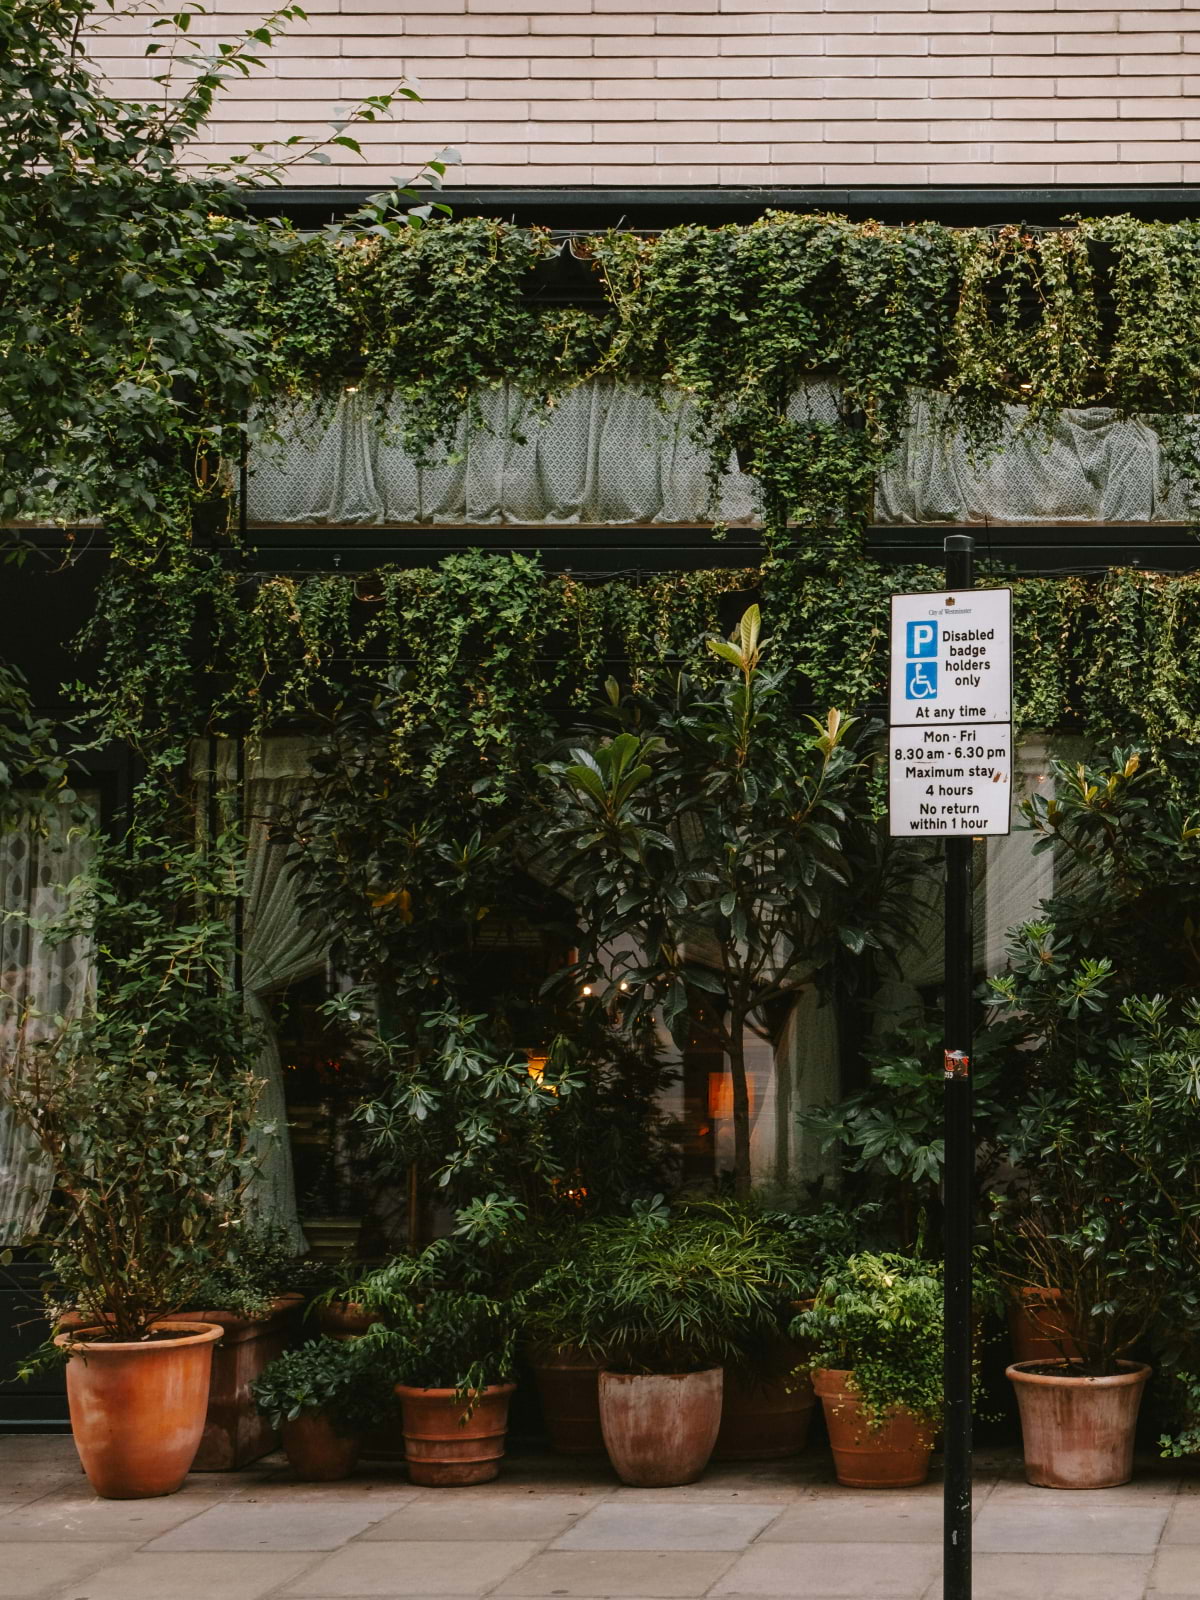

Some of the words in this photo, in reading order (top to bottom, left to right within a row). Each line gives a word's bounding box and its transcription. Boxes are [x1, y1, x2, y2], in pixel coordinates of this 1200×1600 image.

[914, 625, 933, 654] P
[942, 629, 994, 642] Disabled
[950, 645, 986, 658] badge
[945, 660, 990, 671] holders
[955, 675, 980, 687] only
[916, 707, 929, 718] At
[934, 708, 954, 719] any
[959, 705, 986, 717] time
[924, 732, 949, 742] Mon
[960, 731, 976, 742] Fri
[895, 749, 923, 760] 8.30
[927, 750, 944, 759] am
[955, 747, 984, 759] 6.30
[987, 748, 1005, 759] pm
[906, 767, 964, 778] Maximum
[969, 765, 994, 778] stay
[926, 785, 934, 796] 4
[939, 784, 973, 796] hours
[920, 804, 936, 815] No
[942, 803, 979, 814] return
[910, 818, 947, 830] within
[952, 819, 955, 828] 1
[961, 818, 988, 828] hour
